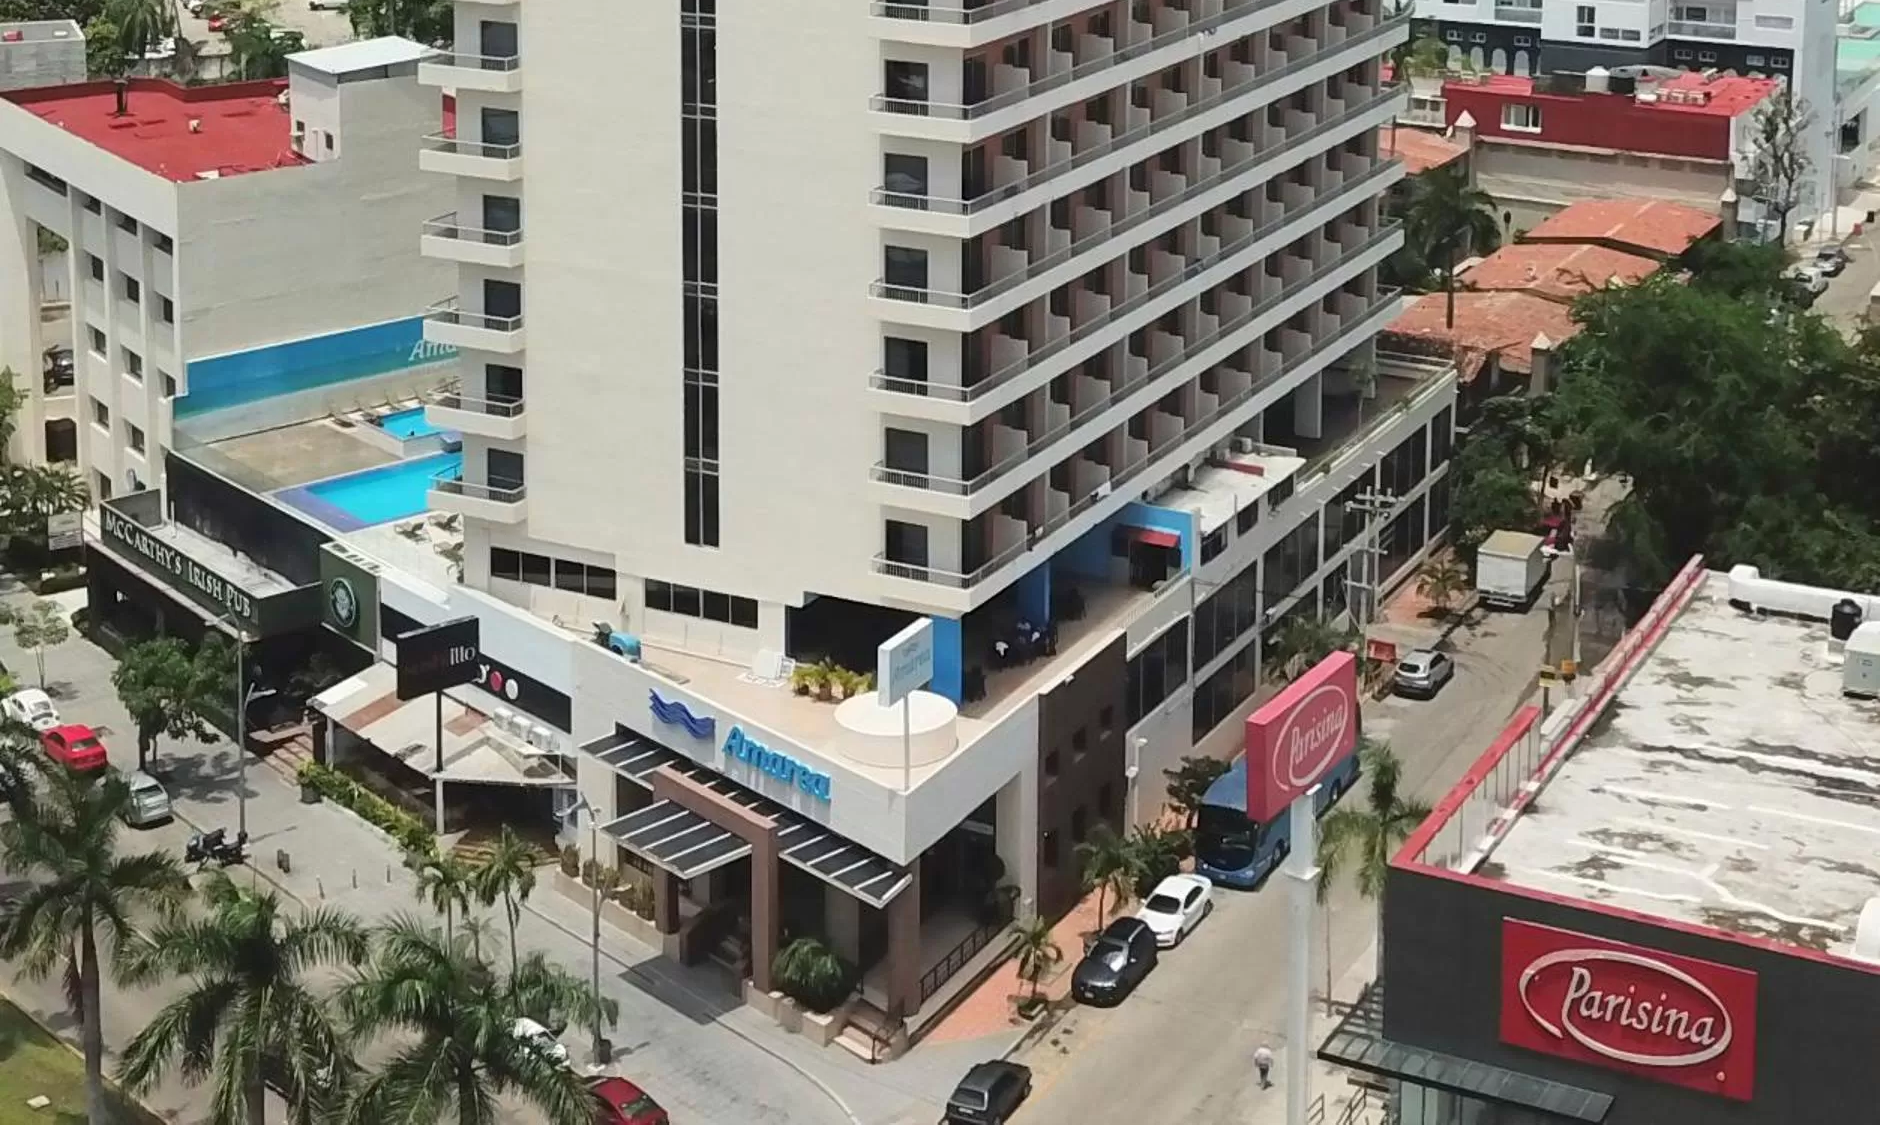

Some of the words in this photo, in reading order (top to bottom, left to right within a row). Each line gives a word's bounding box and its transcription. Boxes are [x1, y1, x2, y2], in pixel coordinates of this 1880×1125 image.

[188, 560, 222, 601] IRISH
[226, 583, 251, 617] PUB
[1290, 704, 1343, 765] Parisina
[1561, 966, 1716, 1046] Parisina
